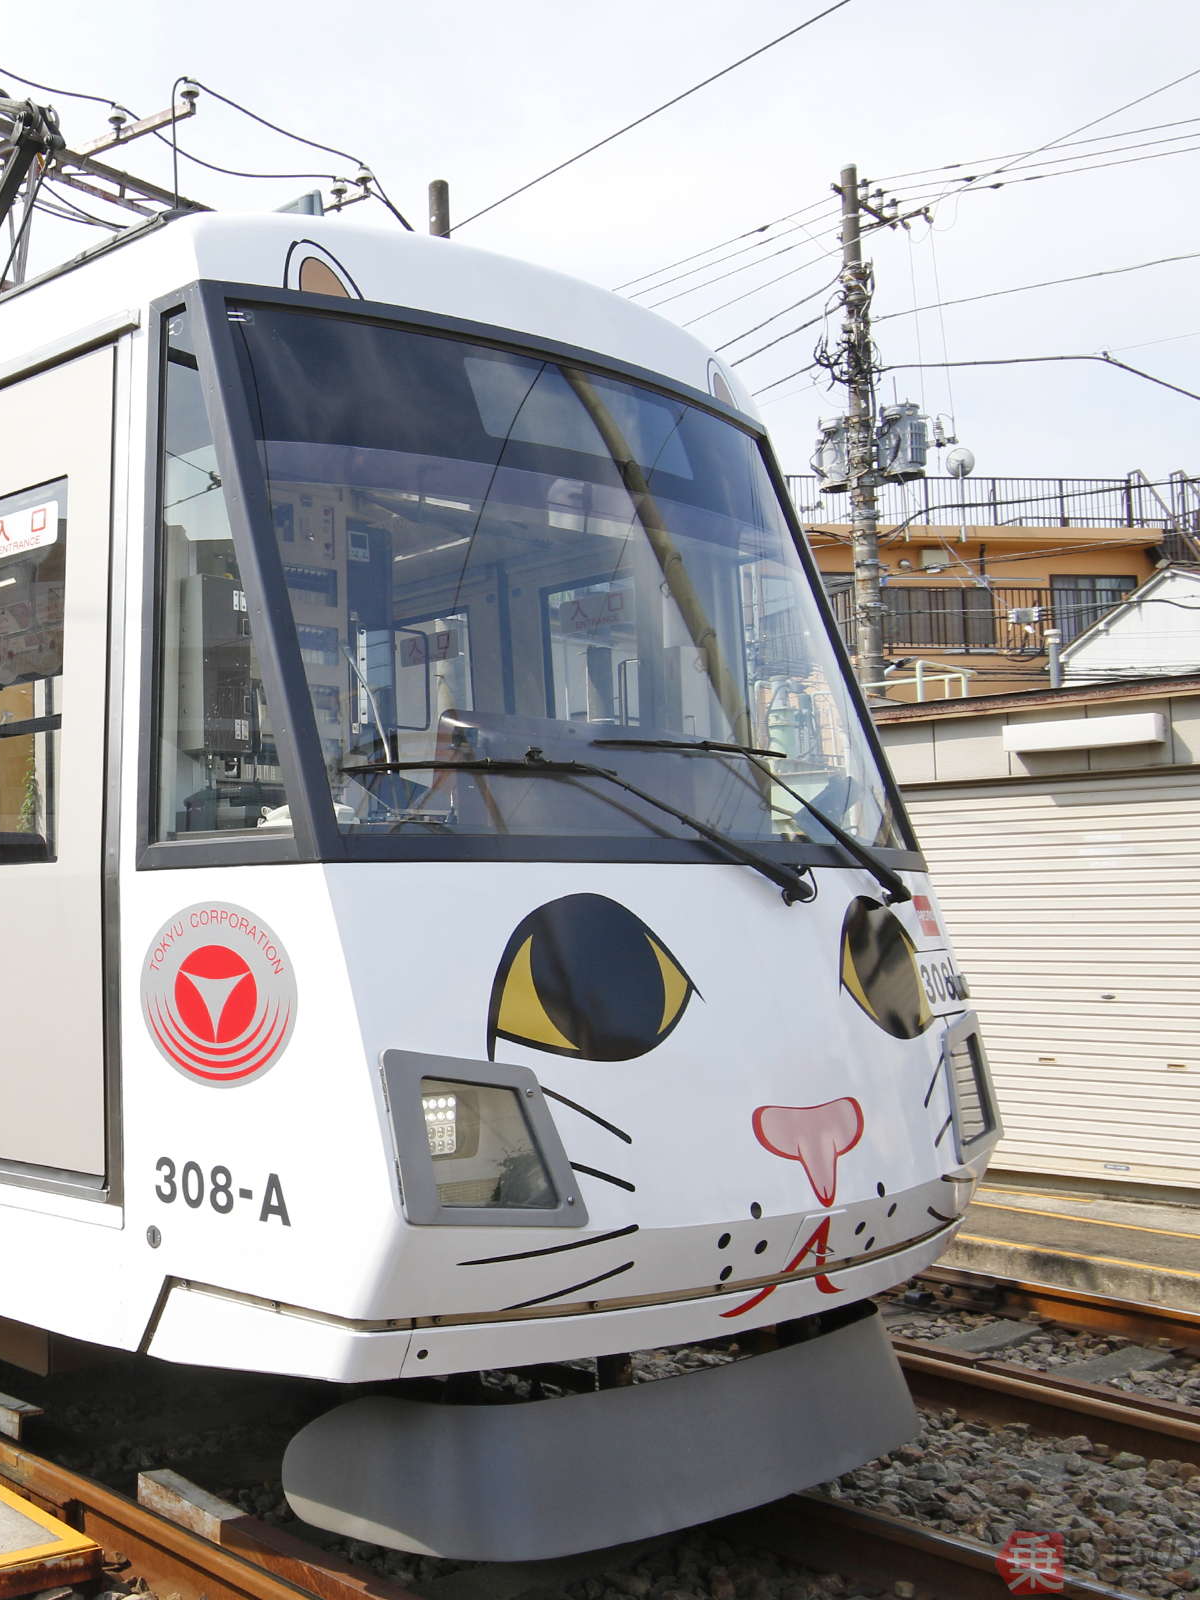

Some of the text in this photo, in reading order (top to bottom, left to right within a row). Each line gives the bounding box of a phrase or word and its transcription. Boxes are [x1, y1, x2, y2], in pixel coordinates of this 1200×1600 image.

[150, 909, 285, 975] TOKYU CORPORATION
[155, 1156, 291, 1227] 308-A
